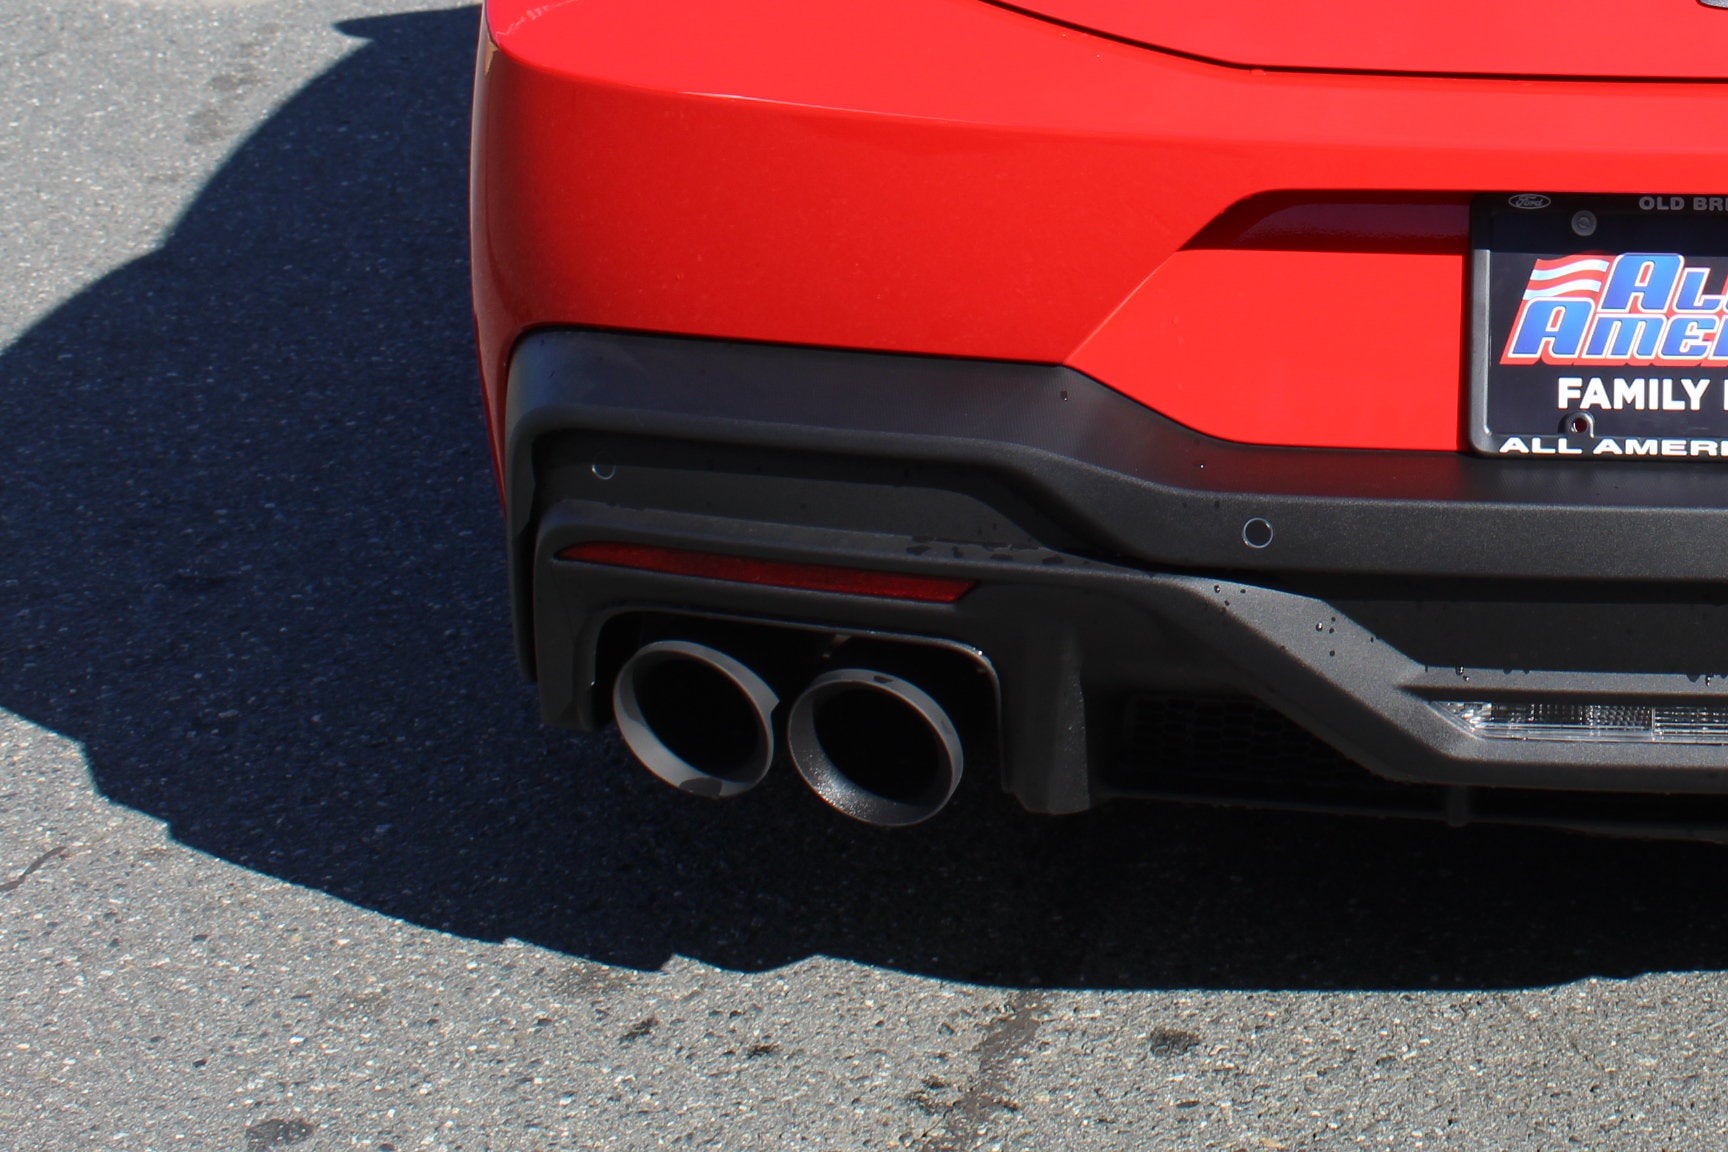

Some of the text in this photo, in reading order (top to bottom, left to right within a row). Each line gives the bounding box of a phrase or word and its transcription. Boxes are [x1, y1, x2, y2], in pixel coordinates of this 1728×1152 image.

[1639, 196, 1685, 211] OLD
[1557, 376, 1711, 411] FAMILY
[1499, 437, 1583, 455] ALL
